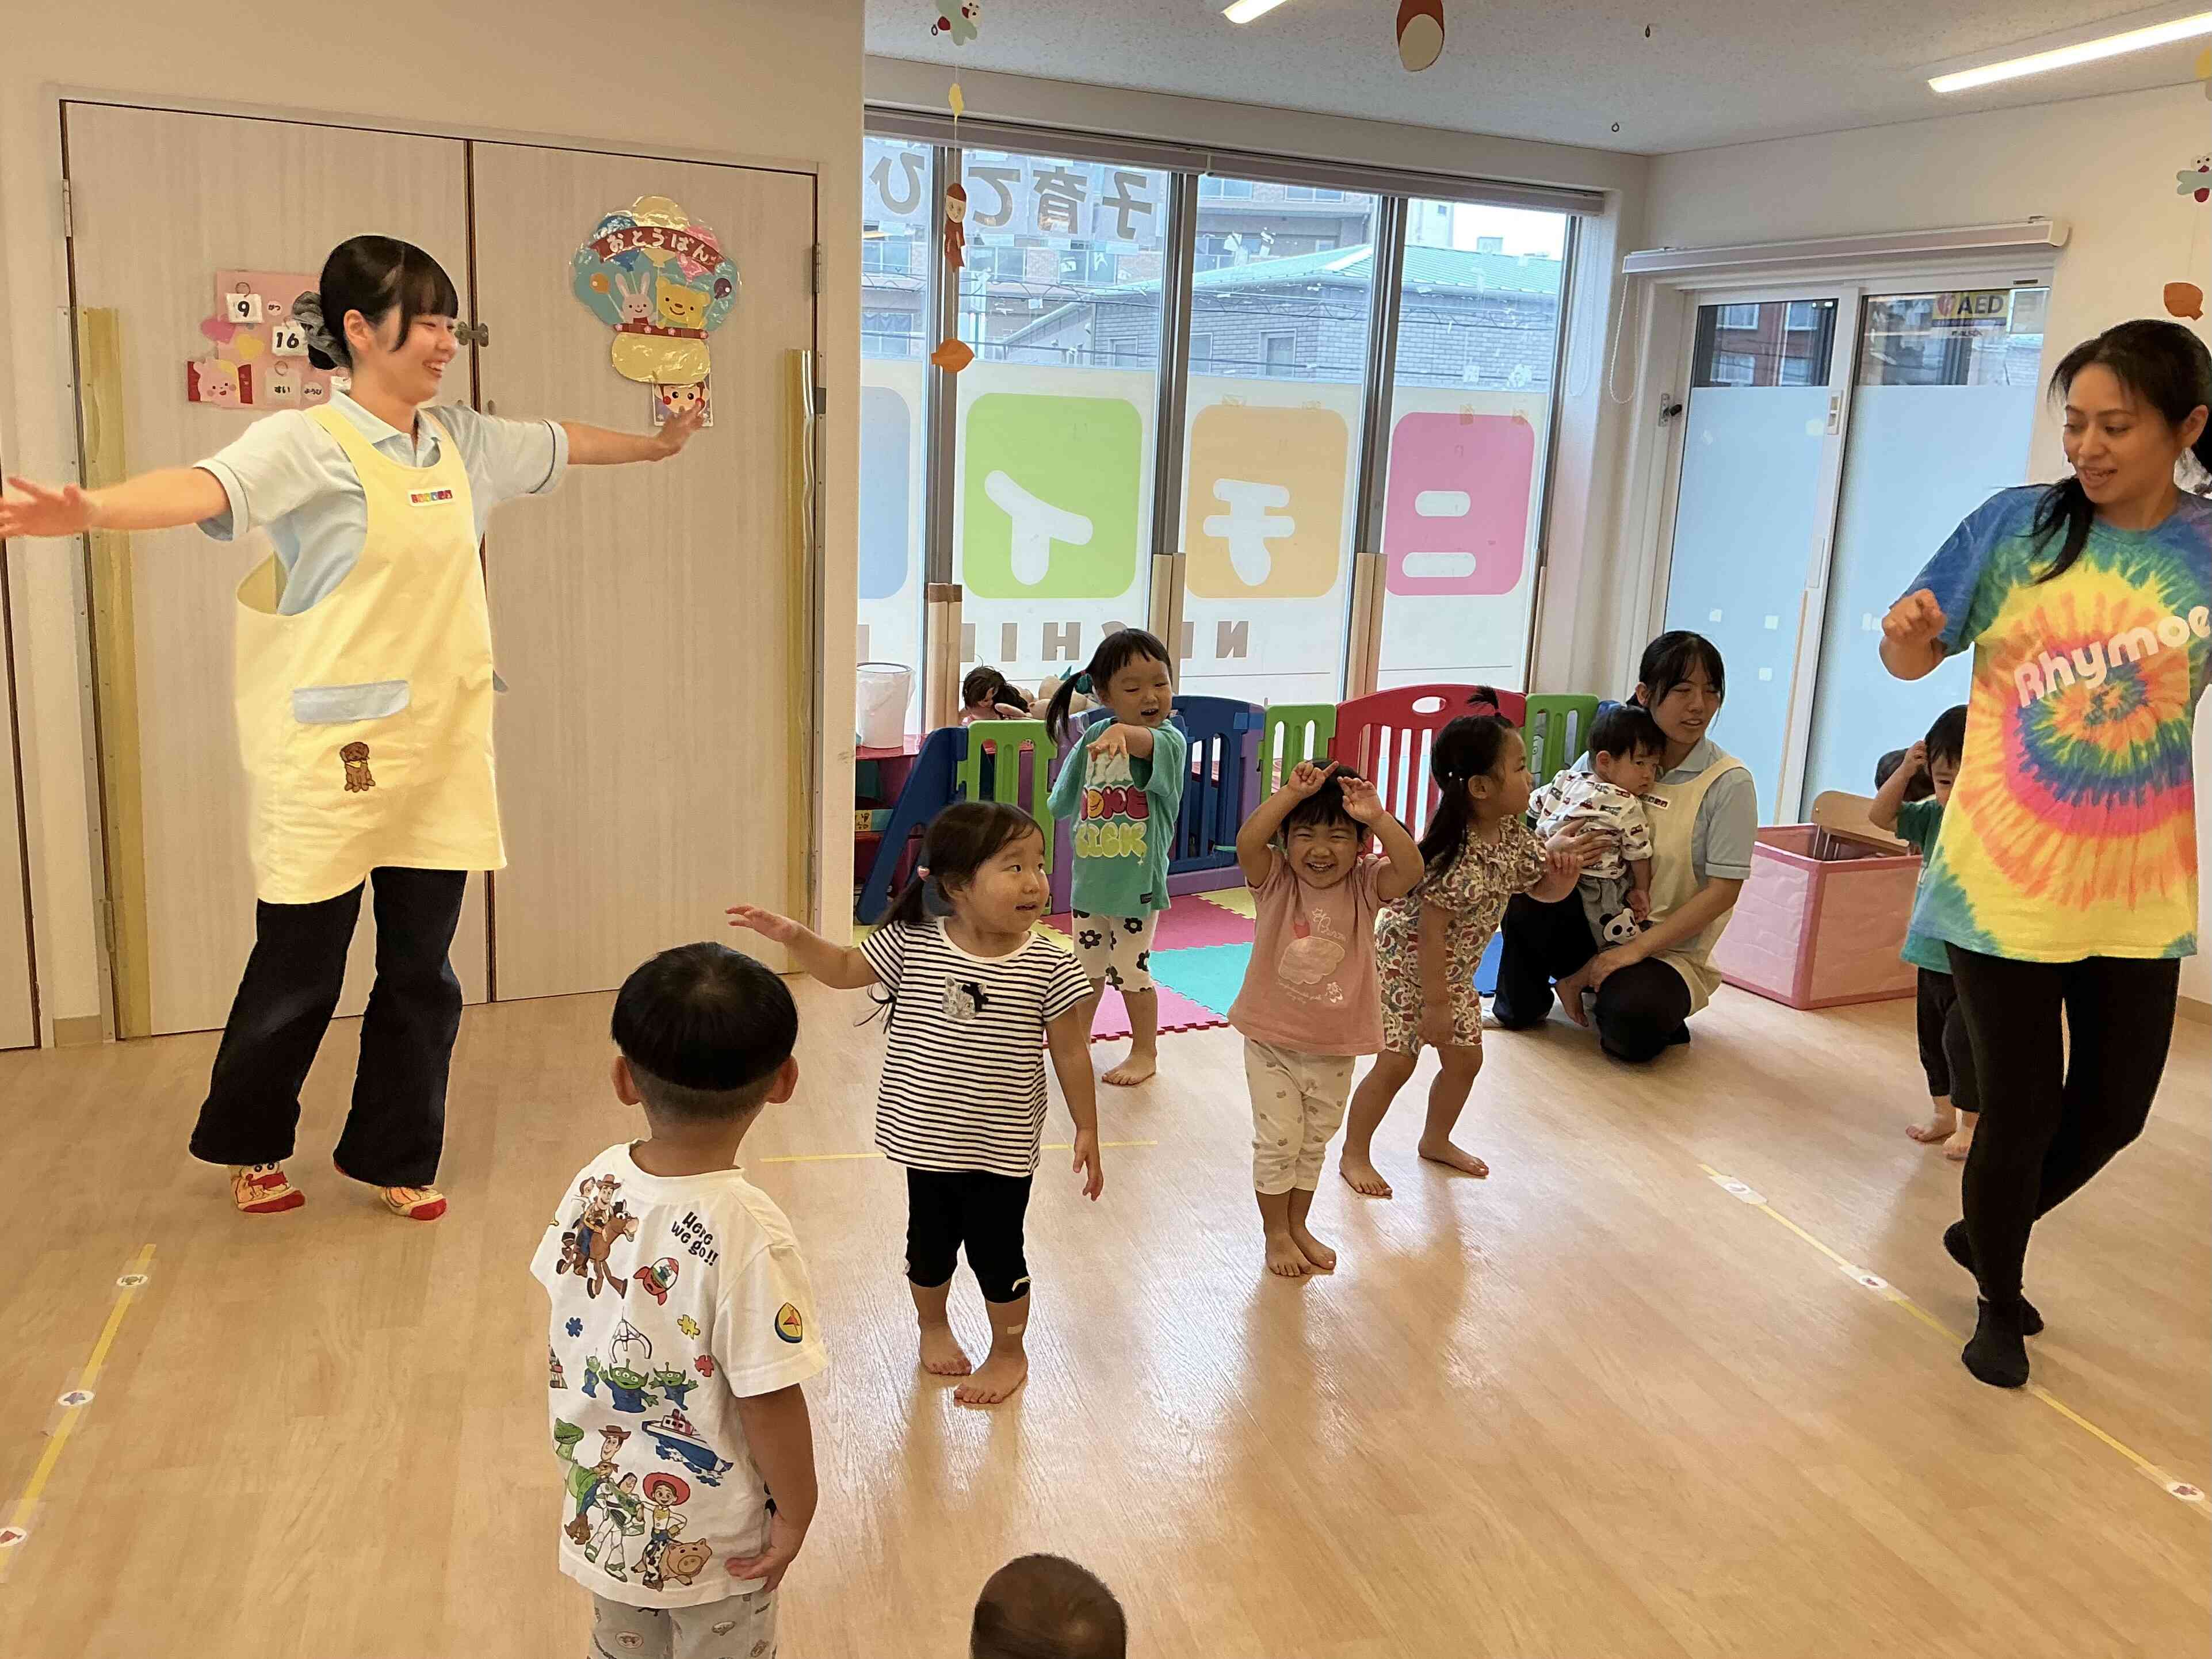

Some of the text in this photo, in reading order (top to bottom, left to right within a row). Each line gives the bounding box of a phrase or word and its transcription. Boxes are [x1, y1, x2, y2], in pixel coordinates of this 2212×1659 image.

[607, 228, 709, 262] おとうばん
[238, 301, 250, 318] 9
[1957, 294, 2004, 315] AED
[276, 332, 299, 349] 16
[2014, 606, 2210, 708] Rhymoe
[671, 1221, 719, 1266] we go!!
[682, 1211, 713, 1245] Here
